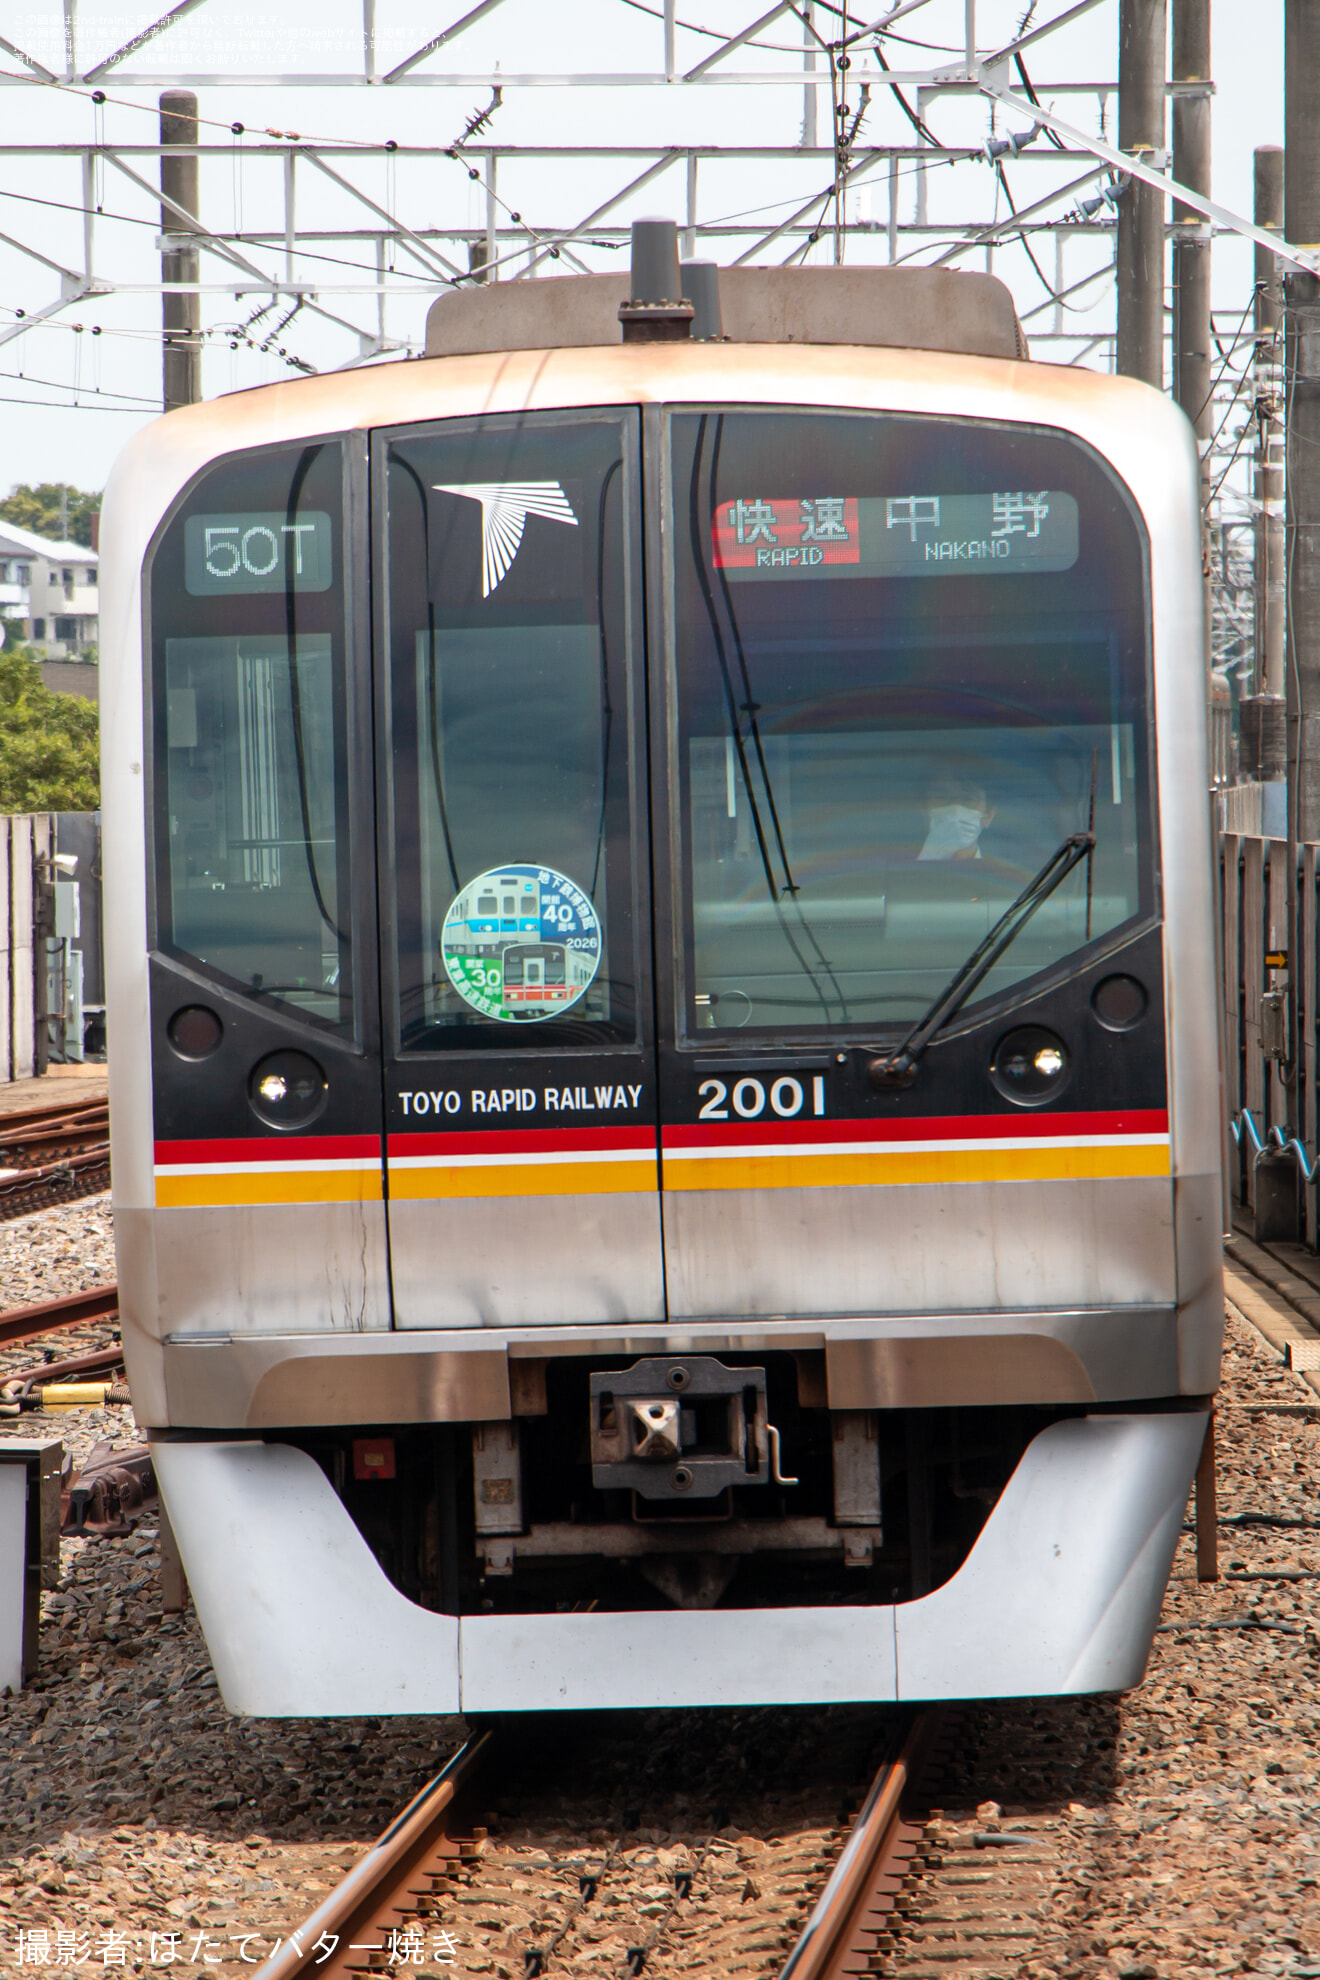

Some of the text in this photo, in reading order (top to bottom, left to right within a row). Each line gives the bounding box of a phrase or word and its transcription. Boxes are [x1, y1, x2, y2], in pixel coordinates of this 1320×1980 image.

[729, 491, 1049, 544] 快速 中野
[205, 525, 315, 576] 50T
[757, 540, 1011, 567] RAPID NAKANO
[543, 905, 573, 923] 40
[566, 937, 598, 949] 2026
[471, 969, 501, 987] 30
[399, 1085, 642, 1115] TOYO RAPID RAILWAY
[698, 1076, 825, 1119] 2001
